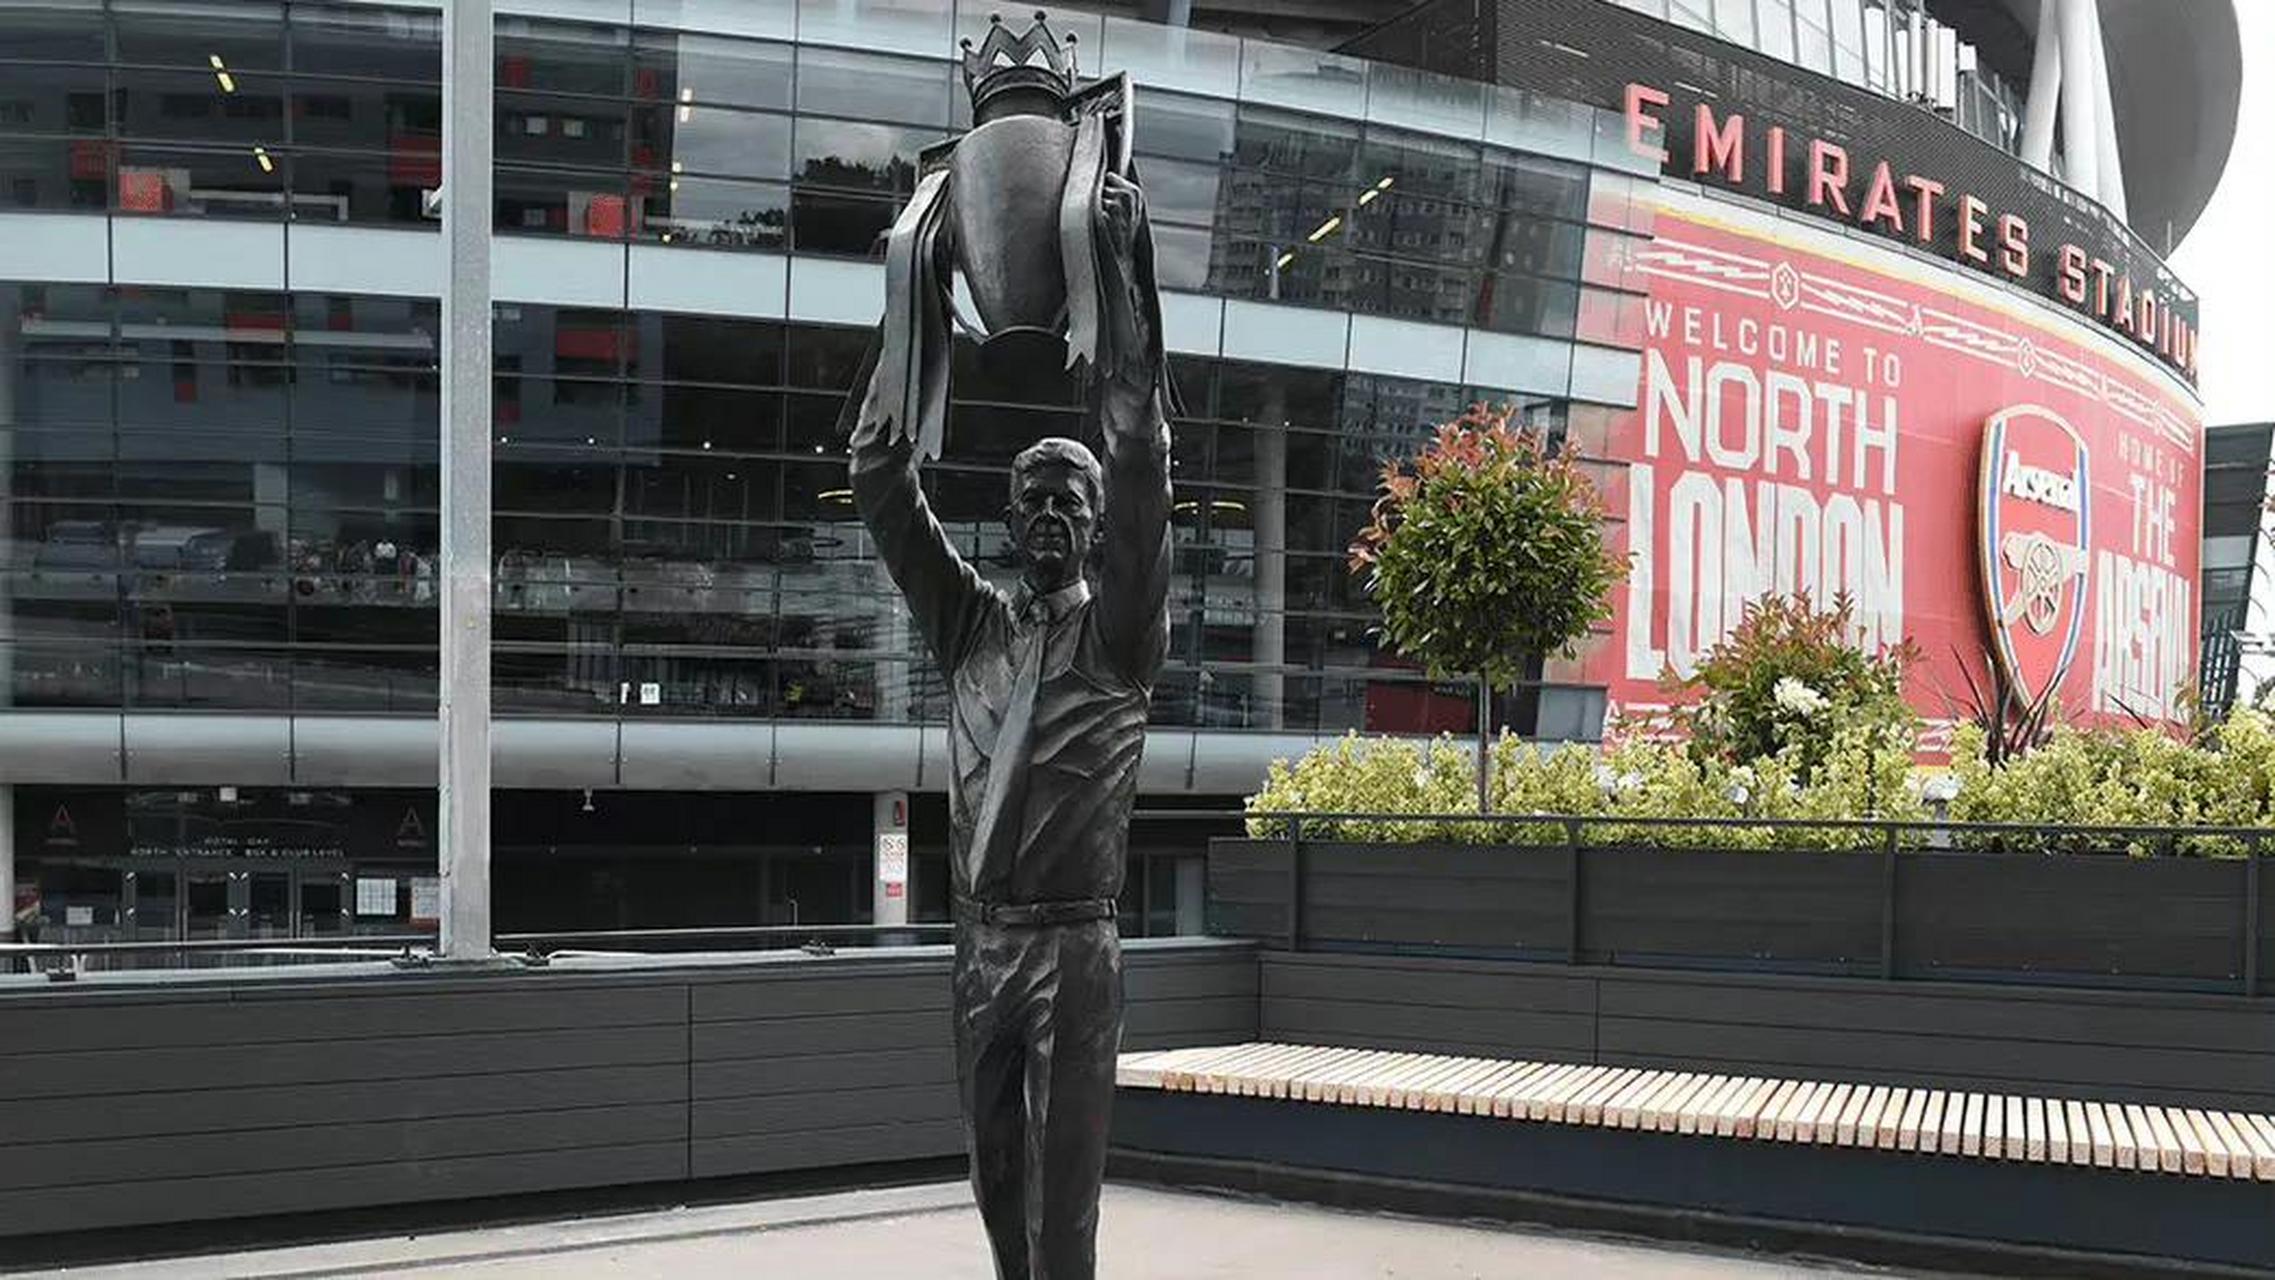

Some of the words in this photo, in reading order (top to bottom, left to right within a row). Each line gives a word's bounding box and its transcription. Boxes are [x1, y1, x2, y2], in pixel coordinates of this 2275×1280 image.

[1625, 83, 2028, 278] EMIRATES
[1645, 299, 1840, 374] WELCOME
[1863, 346, 1900, 388] TO
[1645, 347, 1897, 495] NORTH
[1626, 462, 1904, 683] LONDON
[2130, 473, 2177, 567] THE
